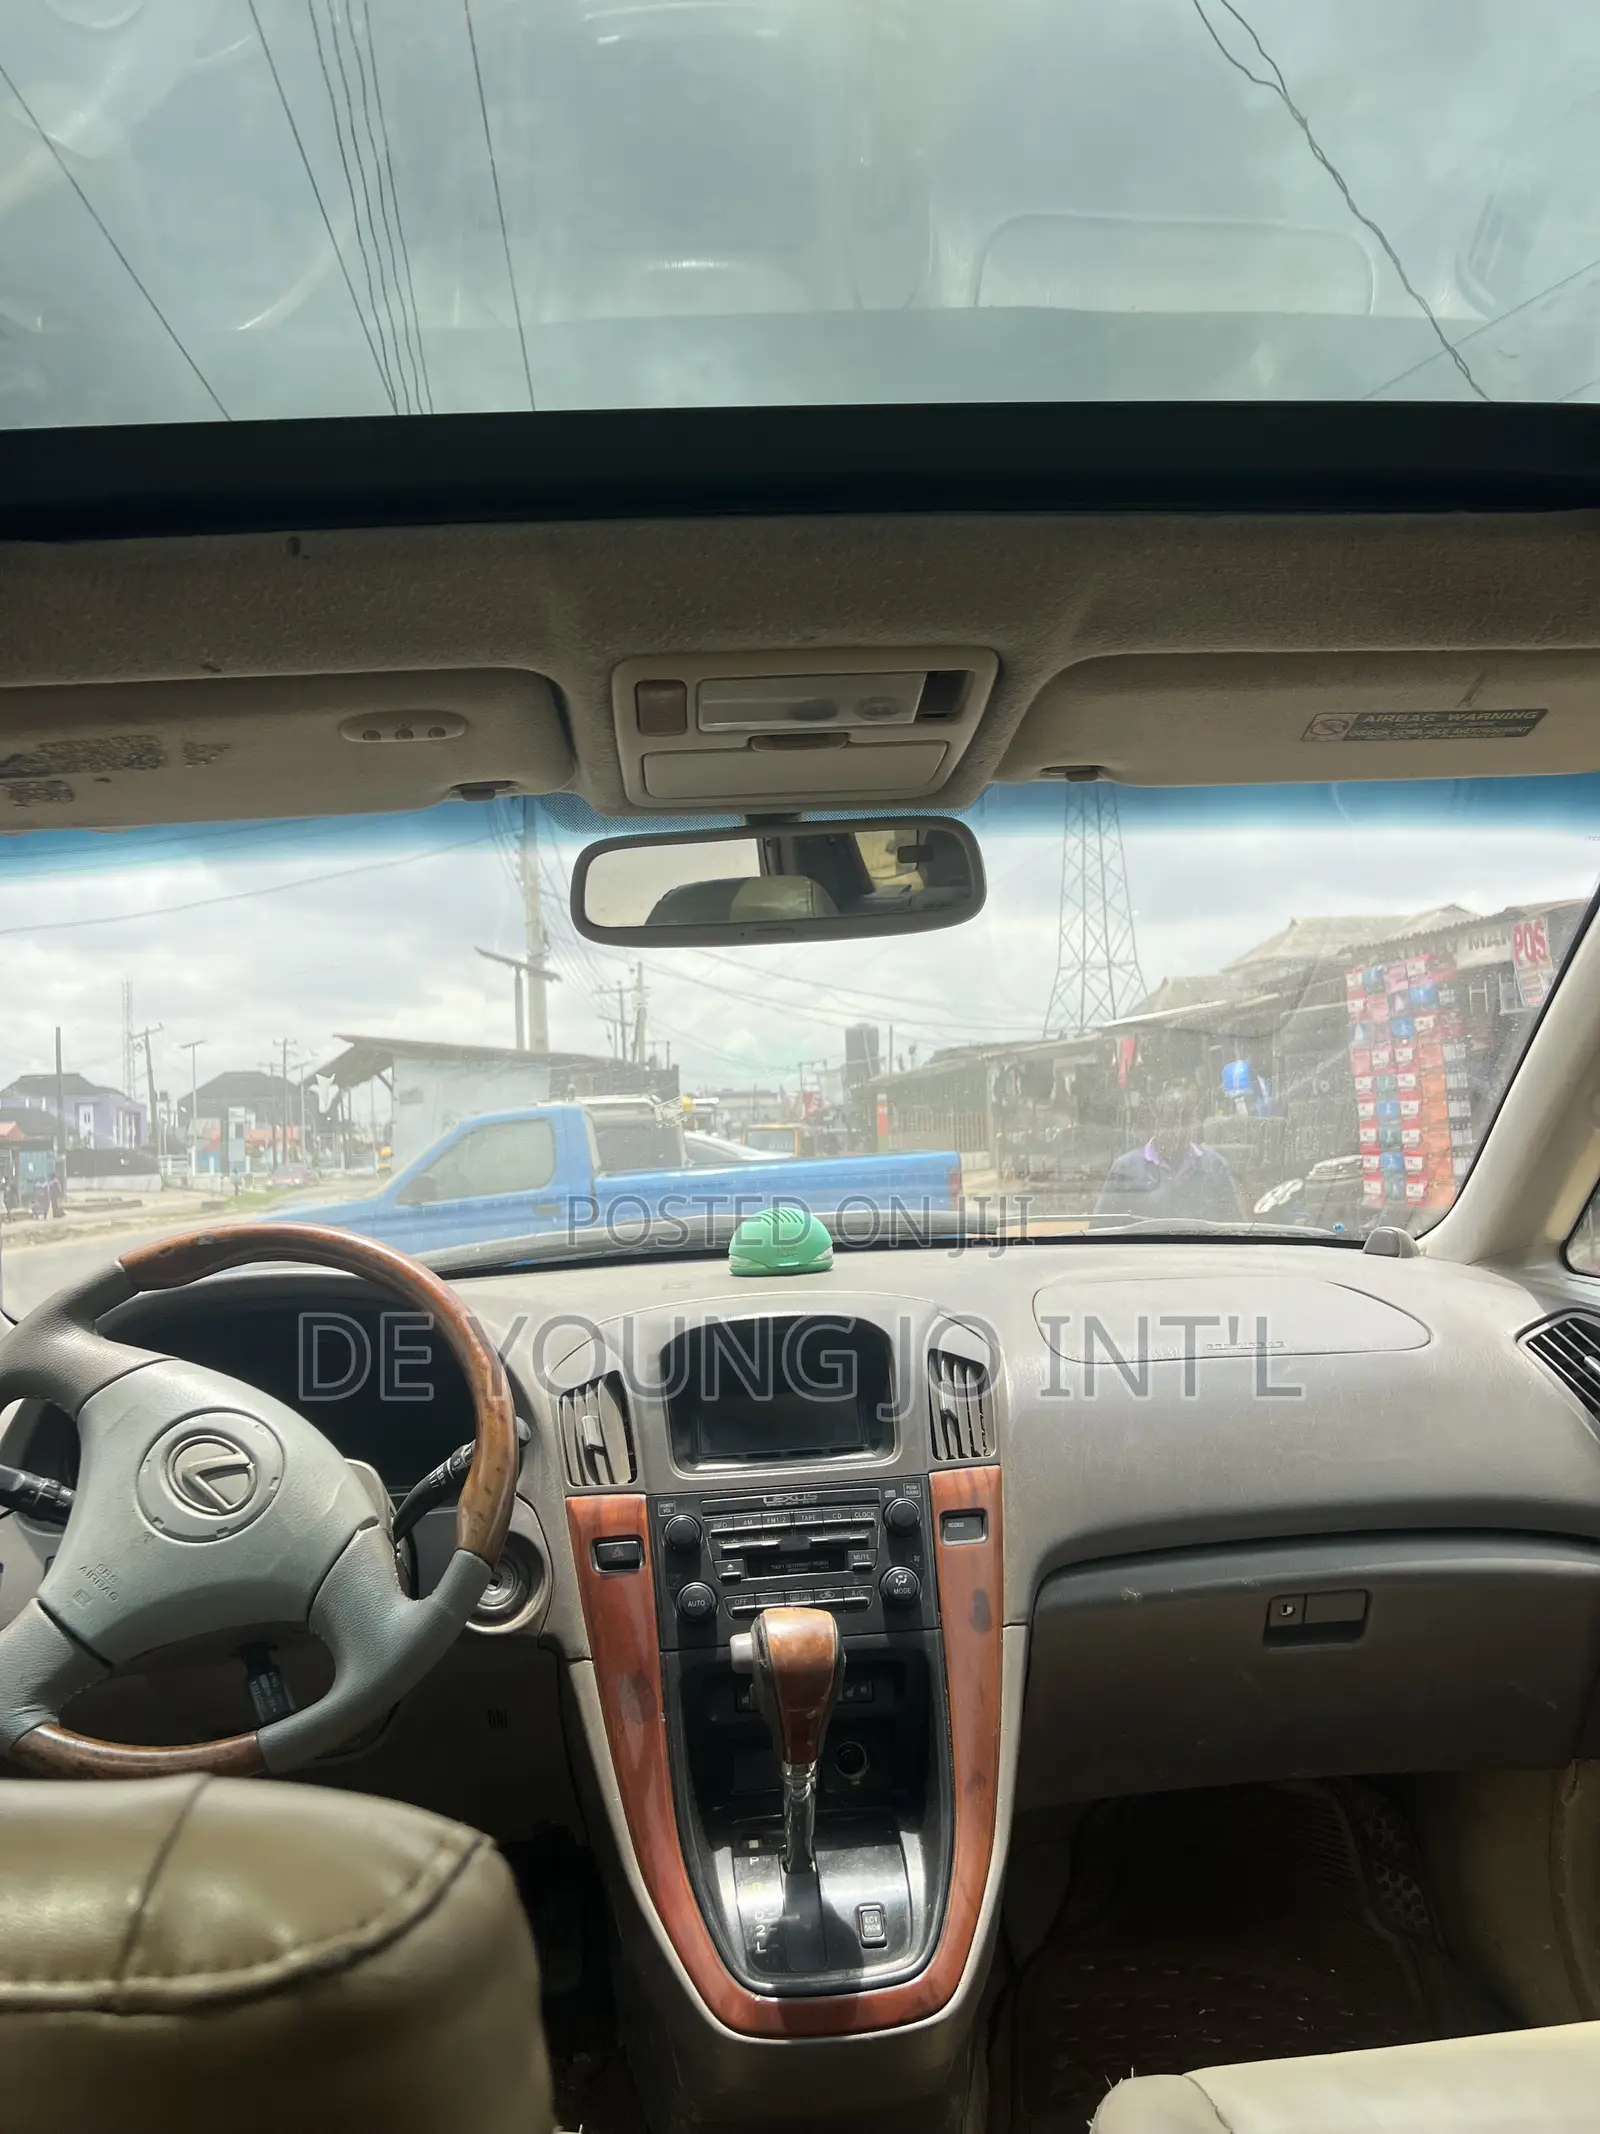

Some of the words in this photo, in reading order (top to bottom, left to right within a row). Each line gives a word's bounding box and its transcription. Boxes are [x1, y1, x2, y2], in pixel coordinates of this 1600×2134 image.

[1362, 713, 1437, 723] AIRBAG
[1447, 711, 1538, 721] WARNING
[1513, 920, 1547, 965] POS
[763, 1493, 818, 1504] LEXUS
[713, 1521, 728, 1529] INFO
[851, 1589, 864, 1597] A/C
[893, 1587, 912, 1595] MODE
[687, 1600, 706, 1608] AUTO
[734, 1598, 748, 1606] OFF
[749, 1857, 760, 1865] P
[864, 1916, 878, 1924] ECT
[755, 1924, 767, 1937] 2
[864, 1924, 881, 1932] SNOW
[756, 1941, 767, 1954] L
